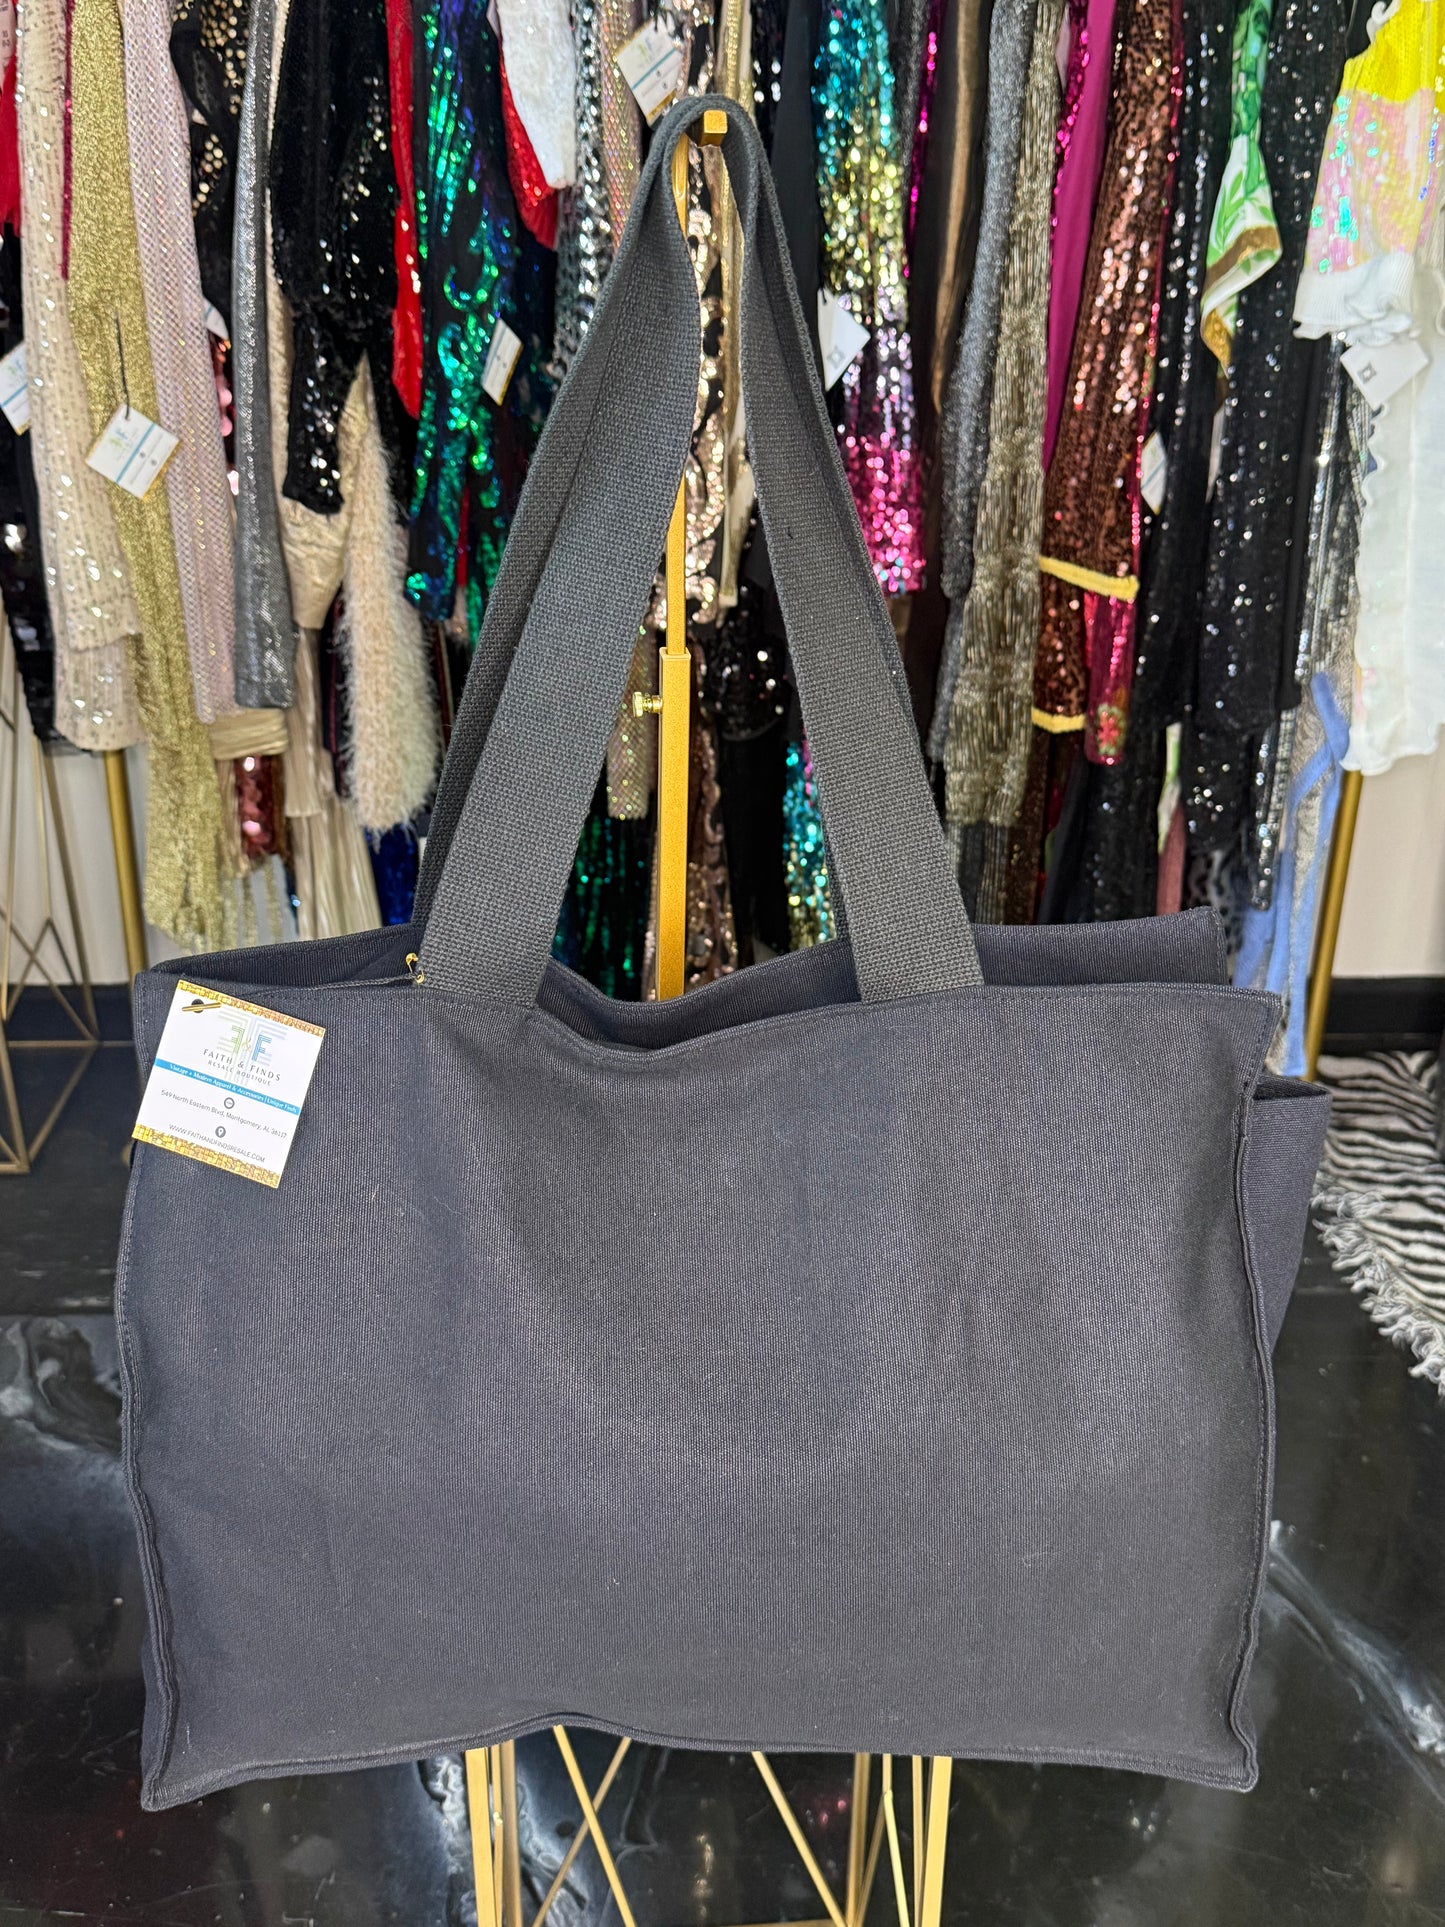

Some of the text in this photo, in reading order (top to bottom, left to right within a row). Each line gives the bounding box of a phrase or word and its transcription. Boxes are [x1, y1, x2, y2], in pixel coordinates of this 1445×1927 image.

[203, 1048, 281, 1082] FAITH & FINDS
[236, 1070, 272, 1087] BOUTIQUE
[161, 1089, 173, 1098] 549
[172, 1093, 189, 1104] North
[189, 1099, 211, 1112] Eastern
[210, 1106, 226, 1118] Blvd,
[225, 1112, 262, 1131] Montgomery,
